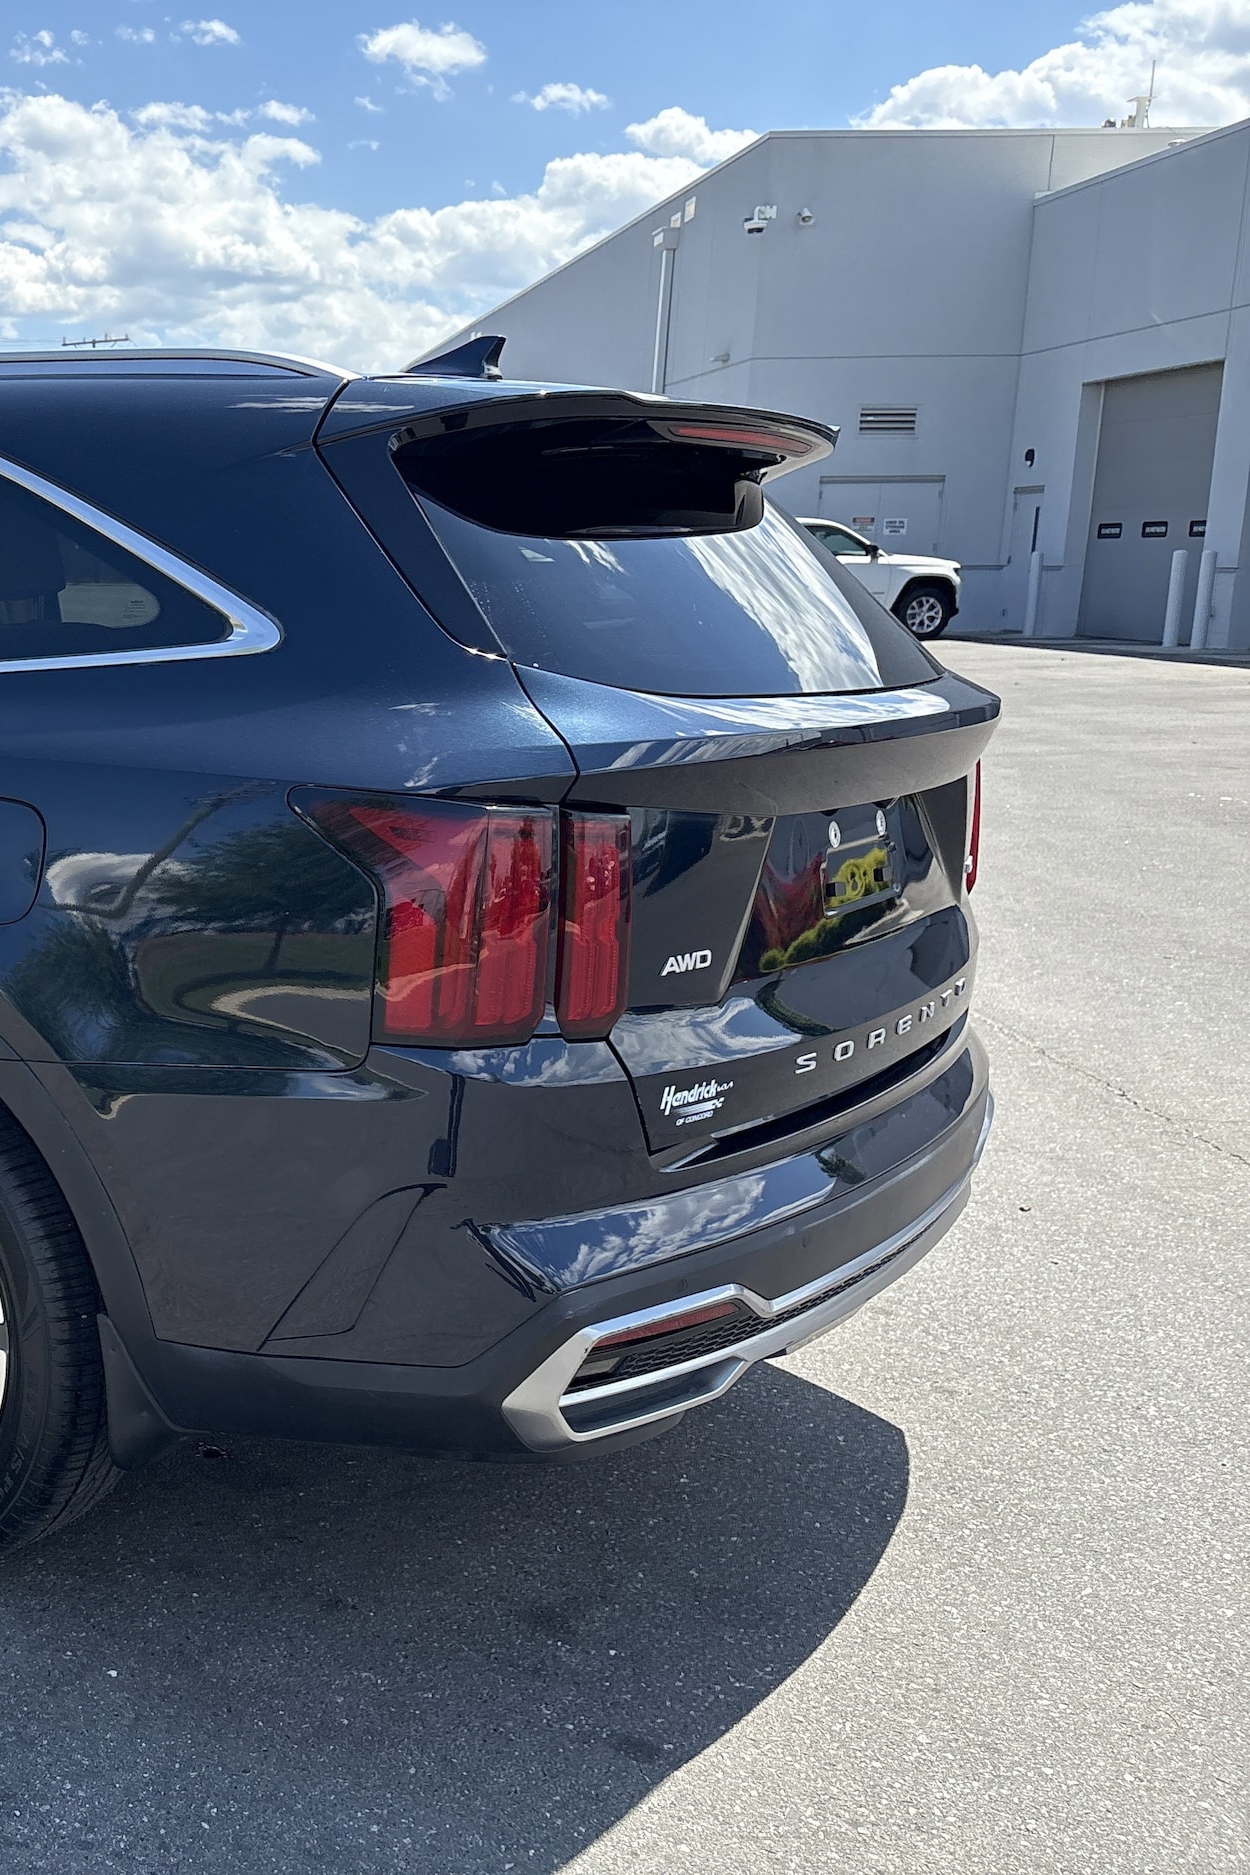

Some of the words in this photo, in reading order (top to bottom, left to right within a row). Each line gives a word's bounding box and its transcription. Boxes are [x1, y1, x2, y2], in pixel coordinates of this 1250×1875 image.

[661, 949, 712, 976] AWD
[794, 977, 966, 1075] SORENTO
[660, 1079, 717, 1116] Hendrick
